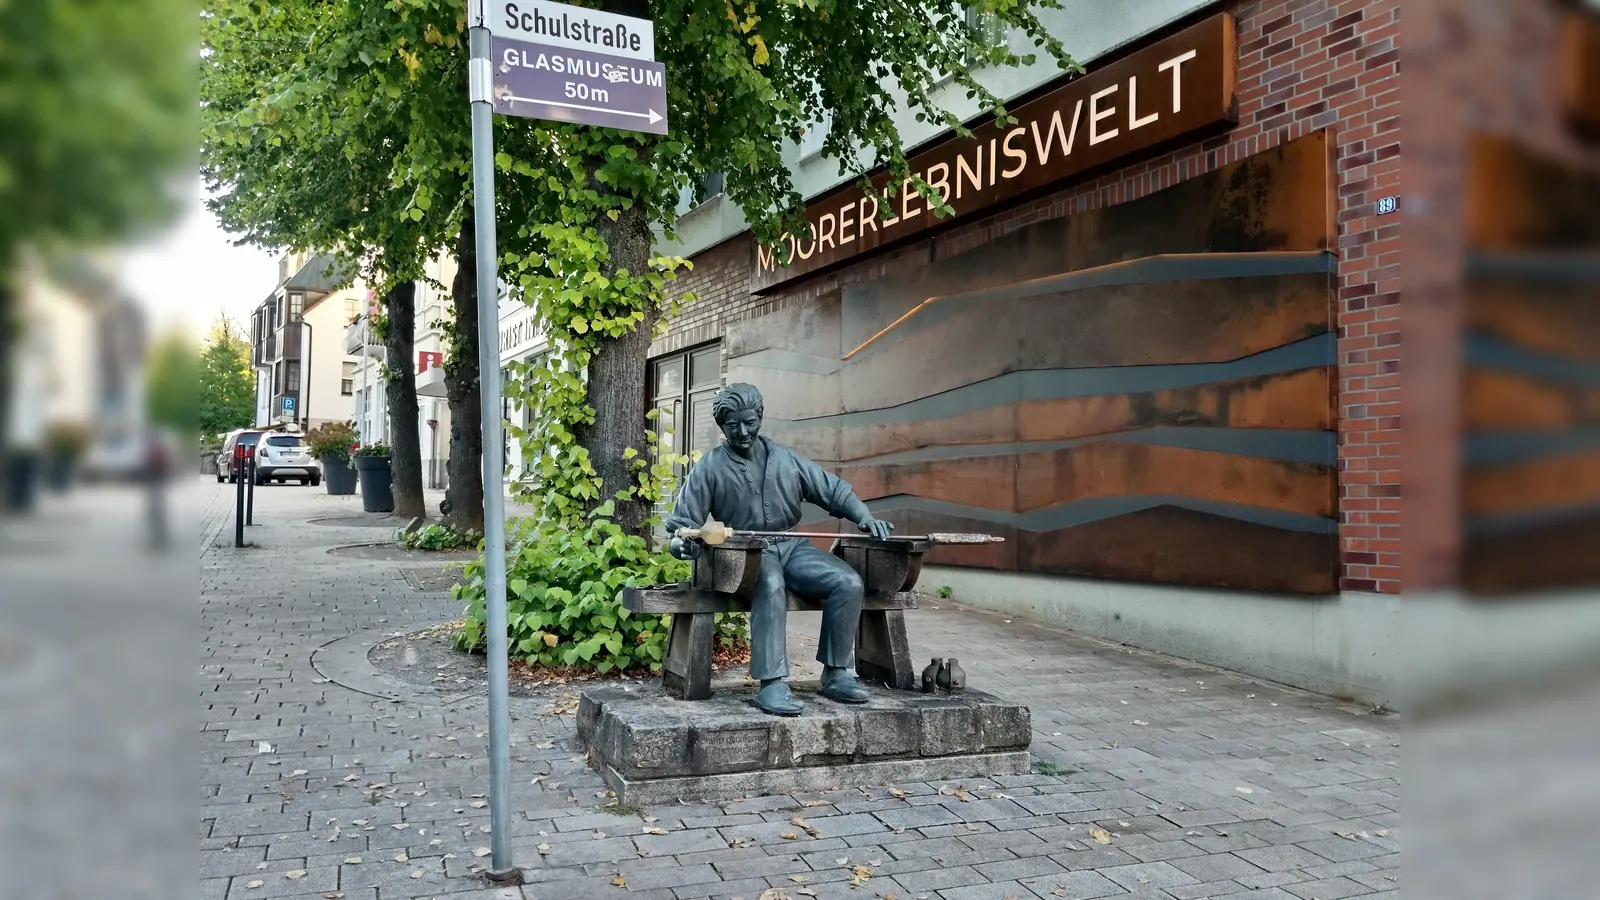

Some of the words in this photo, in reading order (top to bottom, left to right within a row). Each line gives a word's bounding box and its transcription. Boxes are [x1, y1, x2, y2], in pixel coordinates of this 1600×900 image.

[505, 3, 641, 51] Schulstraße
[503, 48, 662, 87] GLASMUSEUM
[756, 49, 1197, 278] MOORERLEBNISWELT
[1380, 198, 1393, 212] 89
